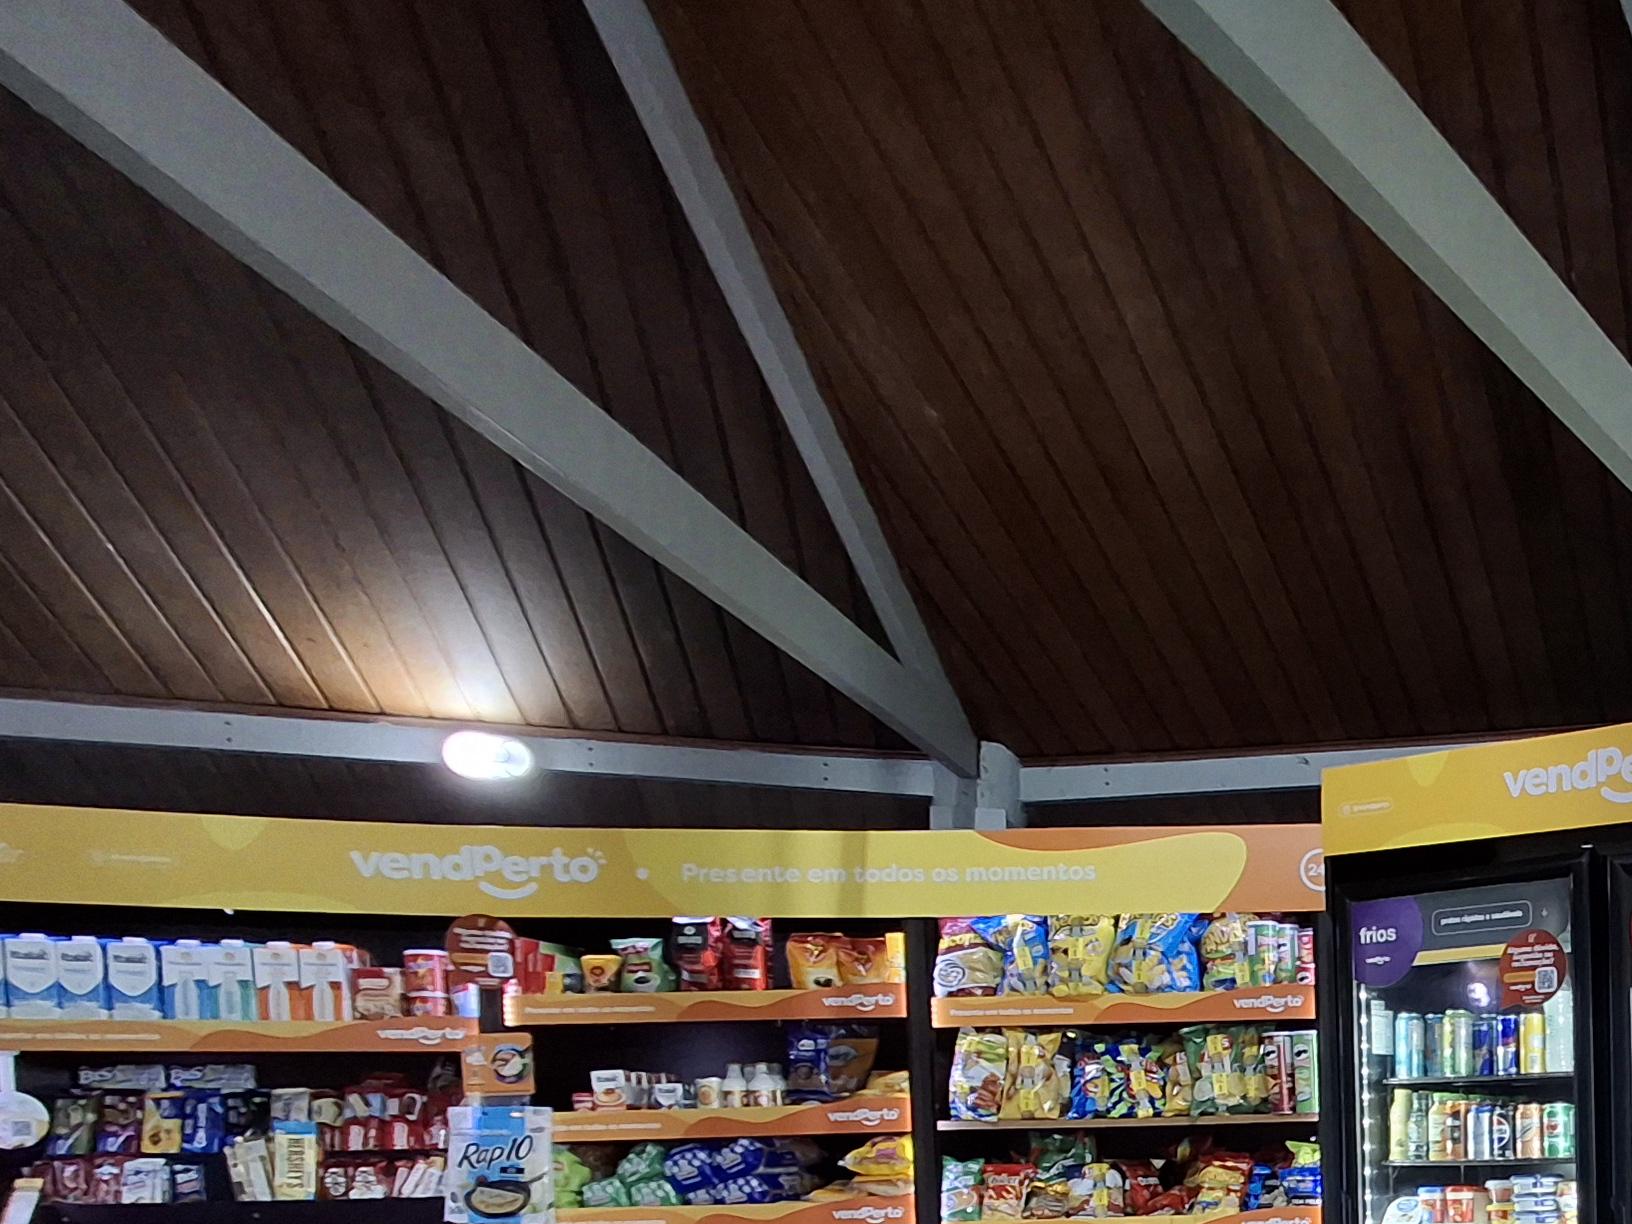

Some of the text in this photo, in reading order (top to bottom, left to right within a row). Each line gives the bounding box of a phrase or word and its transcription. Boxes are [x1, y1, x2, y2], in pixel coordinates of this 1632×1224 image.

[350, 845, 600, 886] vendPerto
[680, 862, 1097, 884] Presente em todos os momentos
[1359, 926, 1397, 945] frios
[457, 1135, 534, 1170] Rap10
